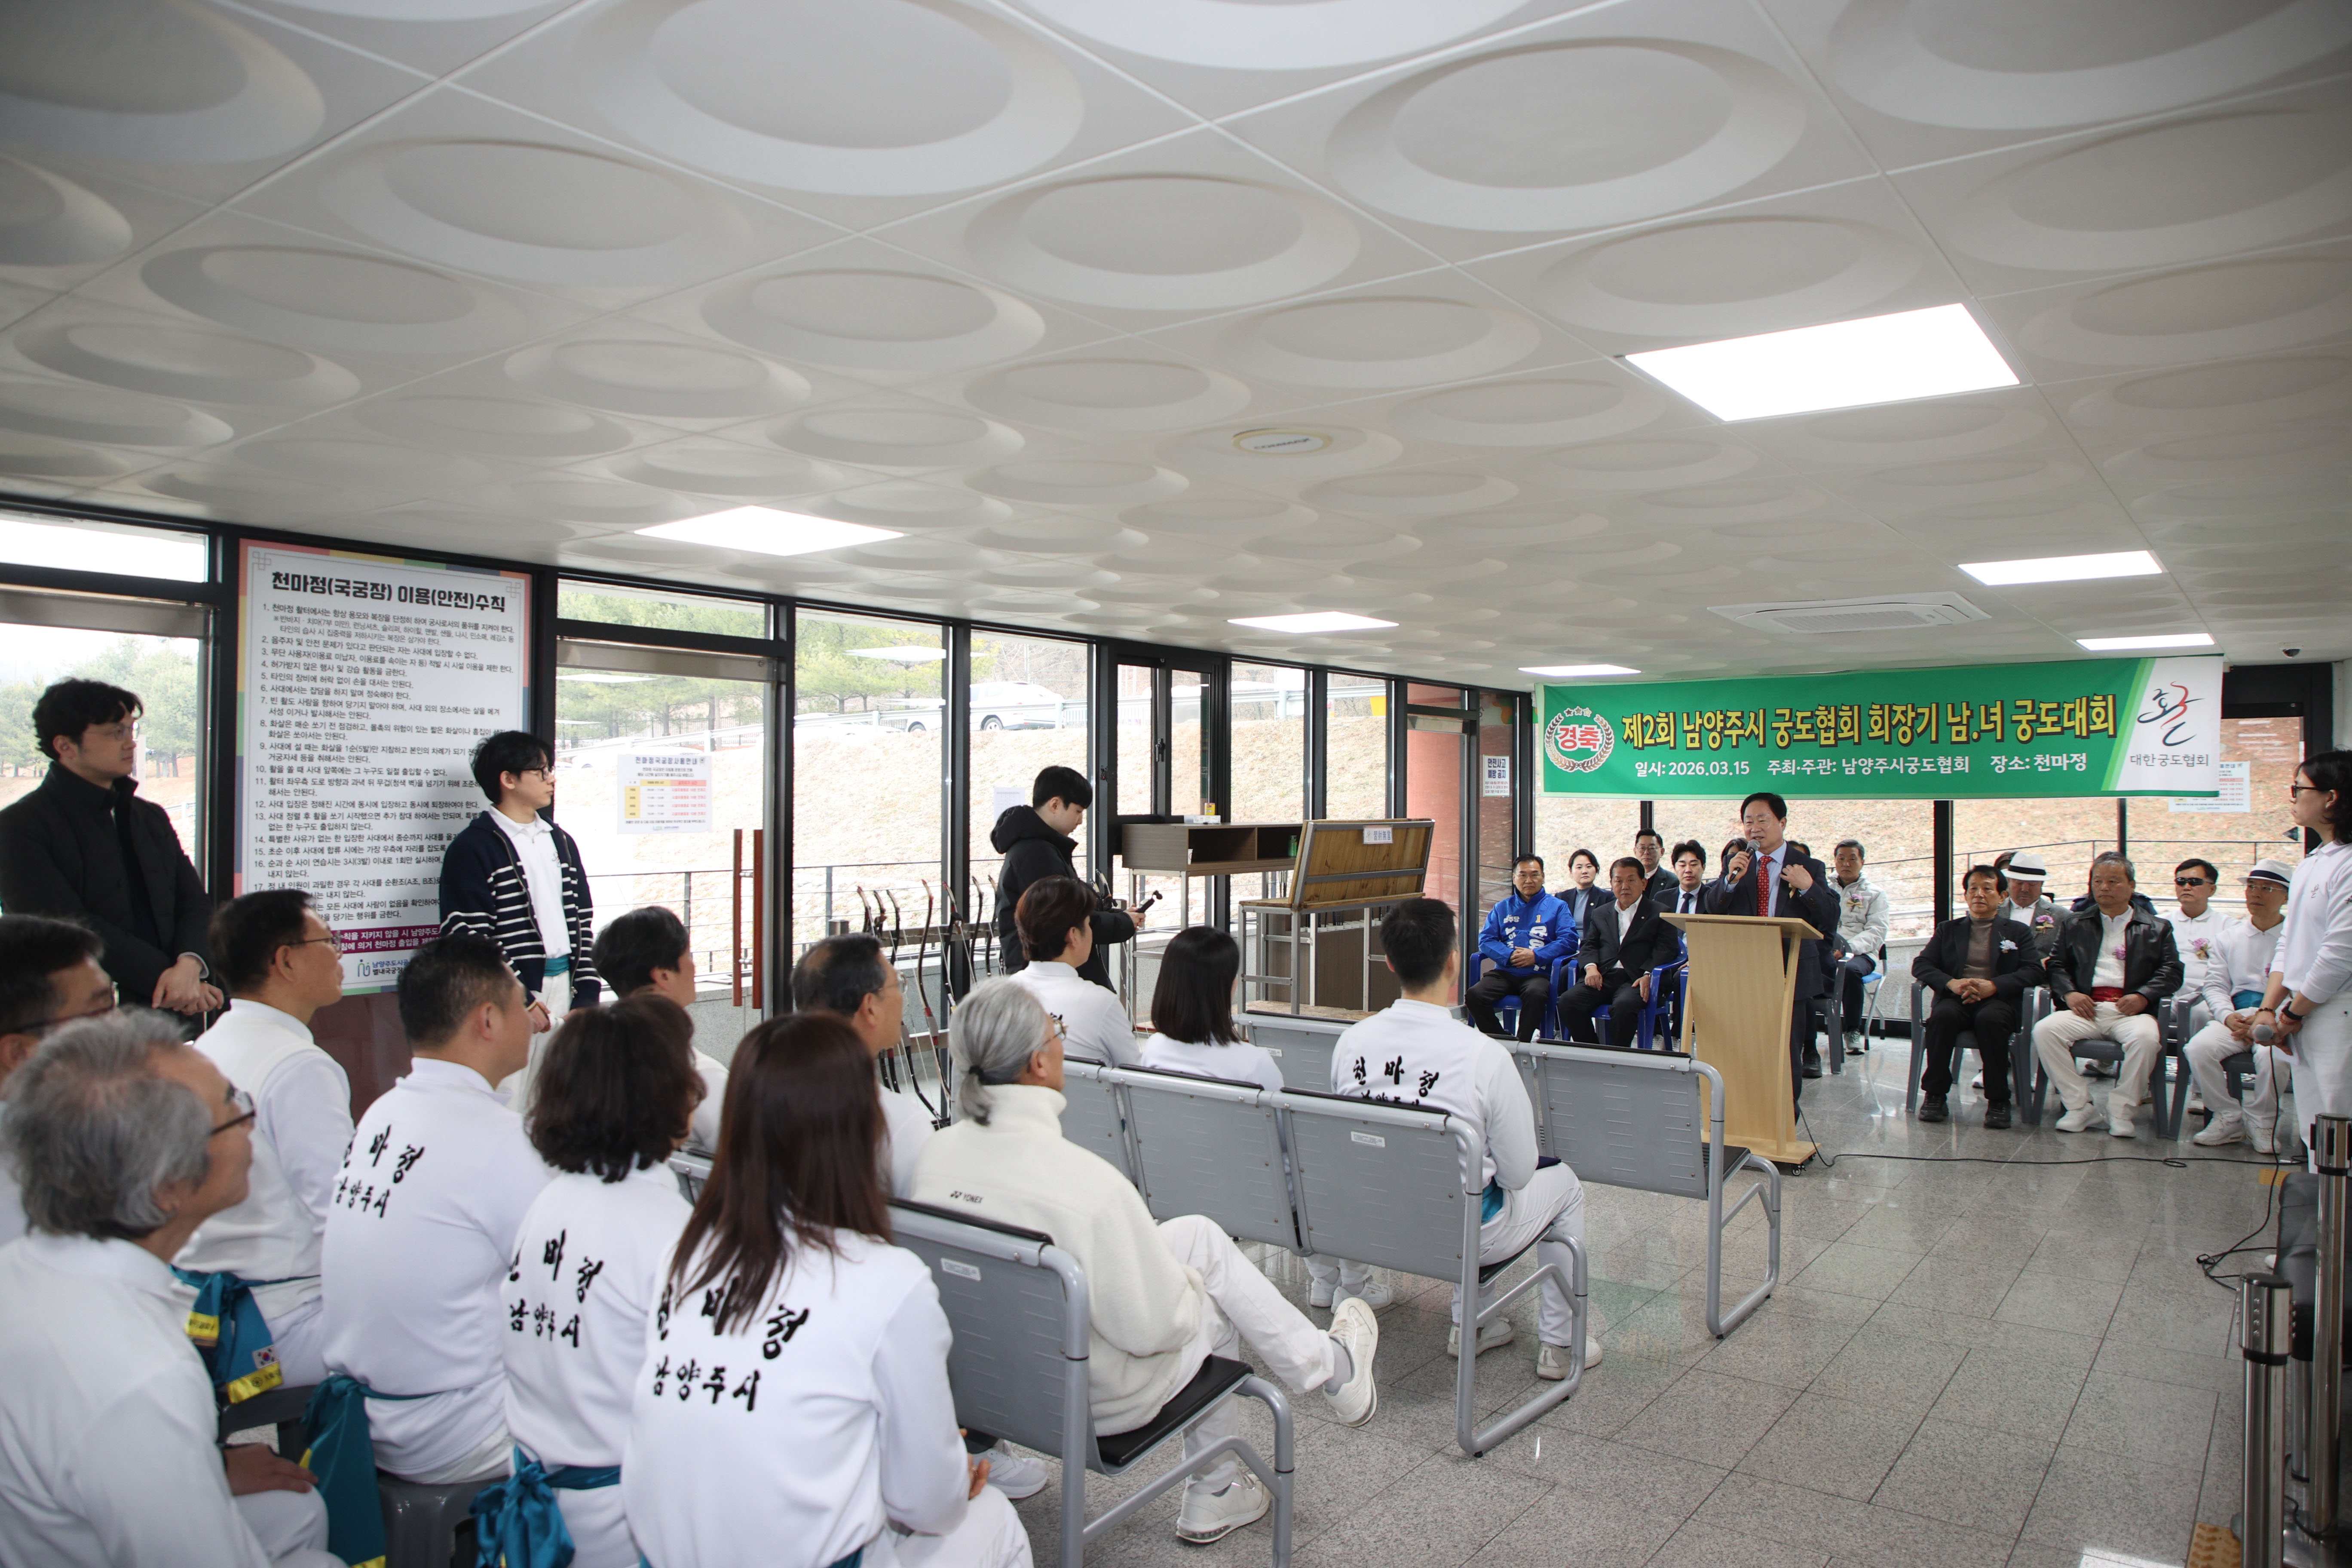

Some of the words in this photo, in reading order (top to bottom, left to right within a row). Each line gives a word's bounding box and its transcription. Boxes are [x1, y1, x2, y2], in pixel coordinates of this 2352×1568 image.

[272, 572, 392, 601] 천마정(국궁장)
[398, 586, 505, 612] 이용(안전)수칙
[273, 604, 293, 613] 천마정
[296, 606, 330, 616] 활터에서는
[333, 609, 347, 618] 항상
[349, 611, 369, 619] 용모와
[371, 613, 390, 622] 복장을
[414, 618, 426, 626] 하여
[429, 619, 459, 628] 궁사로서의
[369, 644, 395, 652] 판단되는
[271, 661, 300, 669] 허가받지
[363, 667, 382, 675] 활동을
[270, 685, 307, 693] 사대에서는
[1622, 709, 1676, 750] 제2회
[1682, 708, 1765, 750] 남양주시
[1771, 704, 1860, 749] 궁도협회
[1868, 702, 1939, 747] 회장기
[1947, 700, 2003, 742] 남.녀
[2011, 693, 2117, 744] 궁도대회
[1558, 725, 1602, 750] 경축
[1488, 758, 1506, 768] 안전사고
[1635, 762, 1666, 777] 일시:
[1668, 761, 1750, 776] 2026.03.15
[1767, 759, 1837, 775] 주최·주관:
[1842, 756, 1969, 775] 남양주시궁도협회
[1991, 755, 2030, 773] 장소:
[2034, 753, 2087, 772] 천마정
[2130, 754, 2208, 767] 대한궁도협회
[1498, 770, 1506, 778] 공지
[1535, 915, 1541, 923] 1
[361, 931, 383, 939] 지키지
[385, 930, 399, 938] 않을
[358, 941, 372, 949] 의거
[398, 938, 420, 947] 출입을
[963, 1193, 984, 1203] YONEX
[510, 1299, 579, 1348] 남양주시
[653, 1355, 760, 1412] 남양주시
